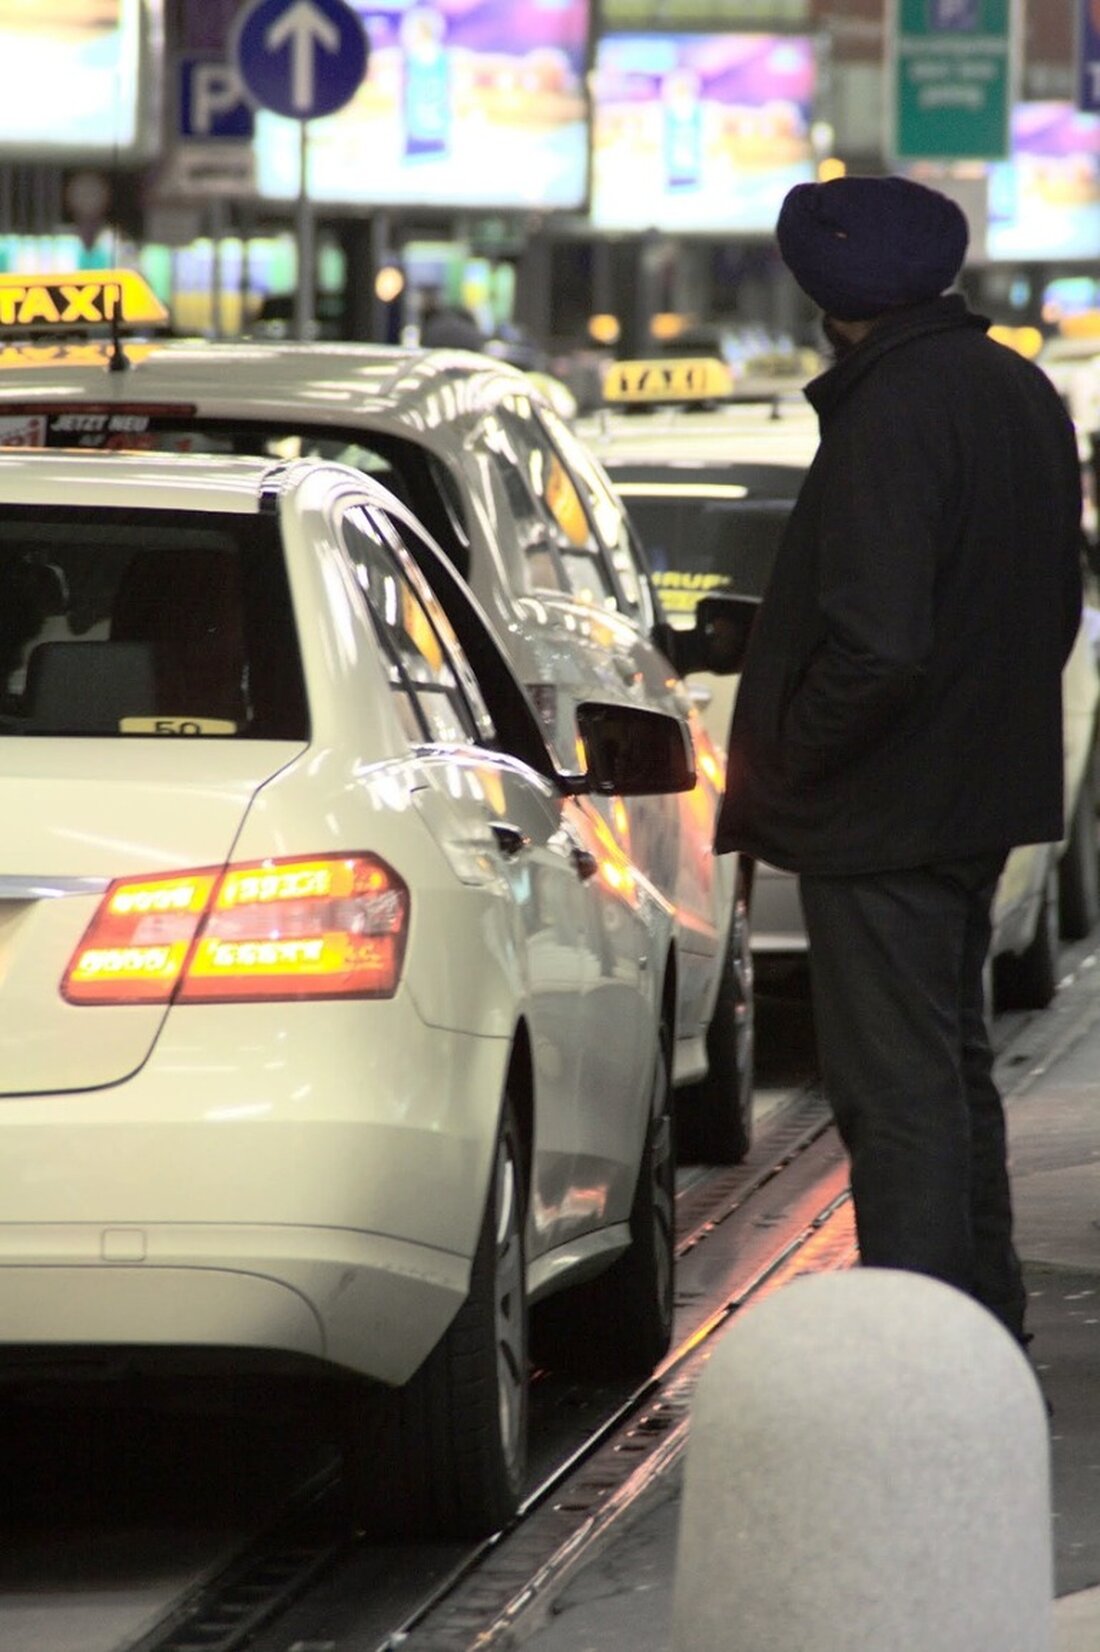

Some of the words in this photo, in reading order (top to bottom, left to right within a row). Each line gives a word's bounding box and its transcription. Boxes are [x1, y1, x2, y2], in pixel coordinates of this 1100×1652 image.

[193, 66, 242, 134] P
[0, 284, 120, 324] TAXI
[611, 365, 706, 396] TAXI
[154, 721, 201, 735] 50
